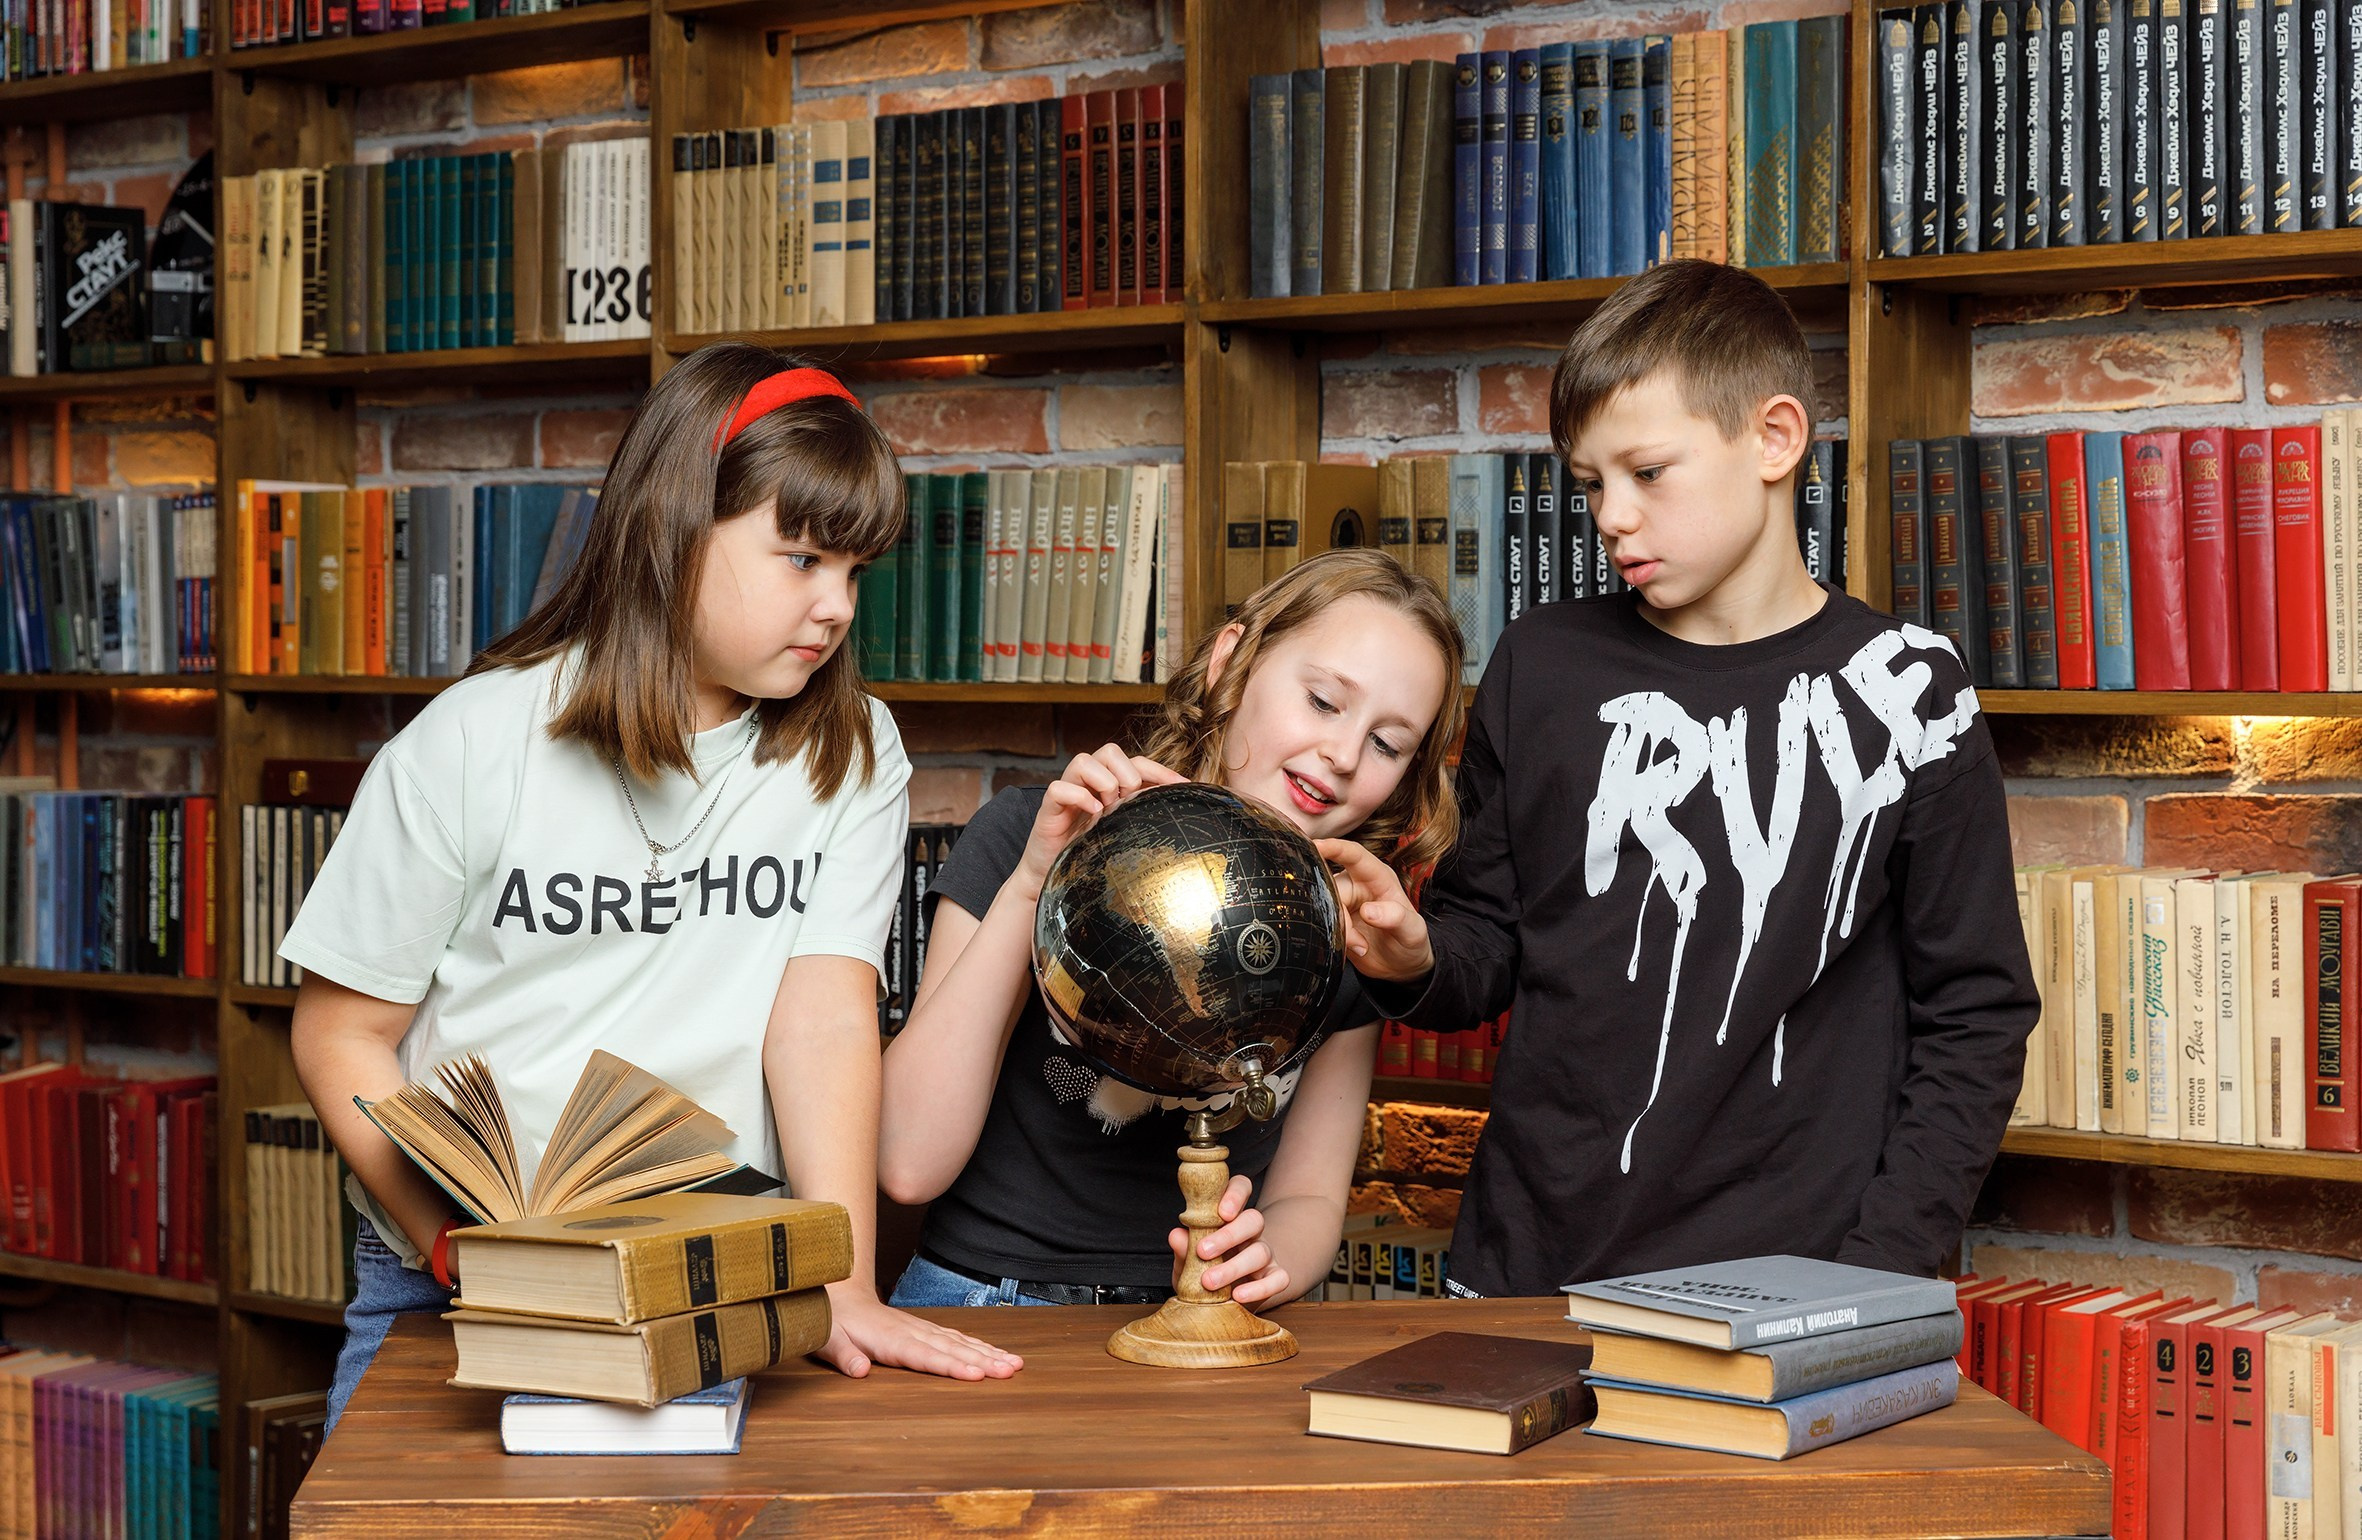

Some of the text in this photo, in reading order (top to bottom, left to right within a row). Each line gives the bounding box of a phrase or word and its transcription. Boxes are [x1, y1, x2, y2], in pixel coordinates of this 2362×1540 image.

[2349, 4, 2362, 50] ЧЕЙЗ
[2026, 36, 2041, 191] Джеймс Хэдли ЧЕЙЗ
[2059, 31, 2074, 187] Джеймс Хэдли ЧЕЙЗ
[2095, 28, 2112, 188] Джеймс Хэдли ЧЕЙЗ
[2134, 23, 2149, 184] Джеймс Хэдли ЧЕЙЗ
[2163, 24, 2181, 186] Джеймс Хэдли ЧЕЙЗ
[2199, 18, 2215, 179] Джеймс Хэдли ЧЕЙЗ
[2236, 19, 2252, 180] Джеймс Хэдли ЧЕЙЗ
[2274, 12, 2290, 176] Джеймс Хэдли ЧЕЙЗ
[2312, 9, 2327, 175] Джеймс Хэдли ЧЕЙЗ
[1891, 53, 1906, 204] Джеймс Хэдли ЧЕЙЗ
[1923, 49, 1938, 202] Джеймс Хэдли ЧЕЙЗ
[1955, 41, 1969, 195] Джеймс Хэдли ЧЕЙЗ
[1993, 42, 2008, 196] Джеймс Хэдли ЧЕЙЗ
[1492, 155, 1503, 211] ТОЛСТОЙ
[2274, 198, 2291, 210] 12
[2310, 196, 2327, 208] 13
[2347, 193, 2362, 206] 14
[1895, 227, 1902, 236] 1
[1924, 225, 1934, 236] 2
[1957, 218, 1968, 229] 3
[1993, 217, 2005, 228] 4
[2027, 214, 2037, 226] 5
[2061, 209, 2070, 220] 6
[2101, 209, 2111, 221] 7
[2135, 205, 2146, 218] 8
[2168, 207, 2179, 219] 9
[2202, 204, 2217, 216] 10
[2240, 203, 2253, 215] 11
[66, 252, 129, 309] СТАУТ
[1021, 285, 1032, 305] 8
[1510, 535, 1521, 620] Рекс СТАУТ
[1538, 534, 1550, 604] кс СТАУТ
[1572, 535, 1583, 584] СТАУТ
[1807, 527, 1820, 579] СТАУТ
[2097, 476, 2124, 646] СВЯЩЕННАЯ ВОЙНА
[2331, 457, 2346, 675] ПОСОБИЕ ДЛЯ ЗАНЯТИЙ ПО РУССКОМУ ЯЗЫКУ
[2061, 540, 2083, 645] СВЯЩЕННАЯ
[1995, 635, 2004, 647] 3
[2033, 638, 2042, 651] 4
[2220, 915, 2233, 1018] А. Н. ТОЛСТОЙ
[2271, 896, 2280, 998] НА ПЕРЕЛОМЕ
[2185, 925, 2205, 1065] Явка с повинной
[2319, 909, 2341, 1074] ВЕЛИКИЙ МОУРАВИ
[2101, 1013, 2113, 1109] КИНЕМАТОГРАФ СЕГОДНЯ
[2197, 1078, 2205, 1126] ЛЕОНОВ
[2323, 1088, 2334, 1103] 6
[1599, 1284, 1744, 1315] Анатолий Калинин
[1618, 1281, 1798, 1304] ЗАПРЕТНАЯ
[1680, 1281, 1761, 1294] ЗОНА
[1756, 1306, 1859, 1339] Анатолий Калинин
[1977, 1322, 1985, 1371] РЫБАКОВ
[2159, 1346, 2172, 1367] 4
[2198, 1349, 2210, 1371] 2
[2237, 1352, 2249, 1374] 3
[1852, 1378, 1943, 1425] ЭМ. КАЗАКЕВИЧ
[2127, 1356, 2136, 1409] ШКОЛА
[2313, 1351, 2323, 1429] ВЕКА СЫНОВЬЯ
